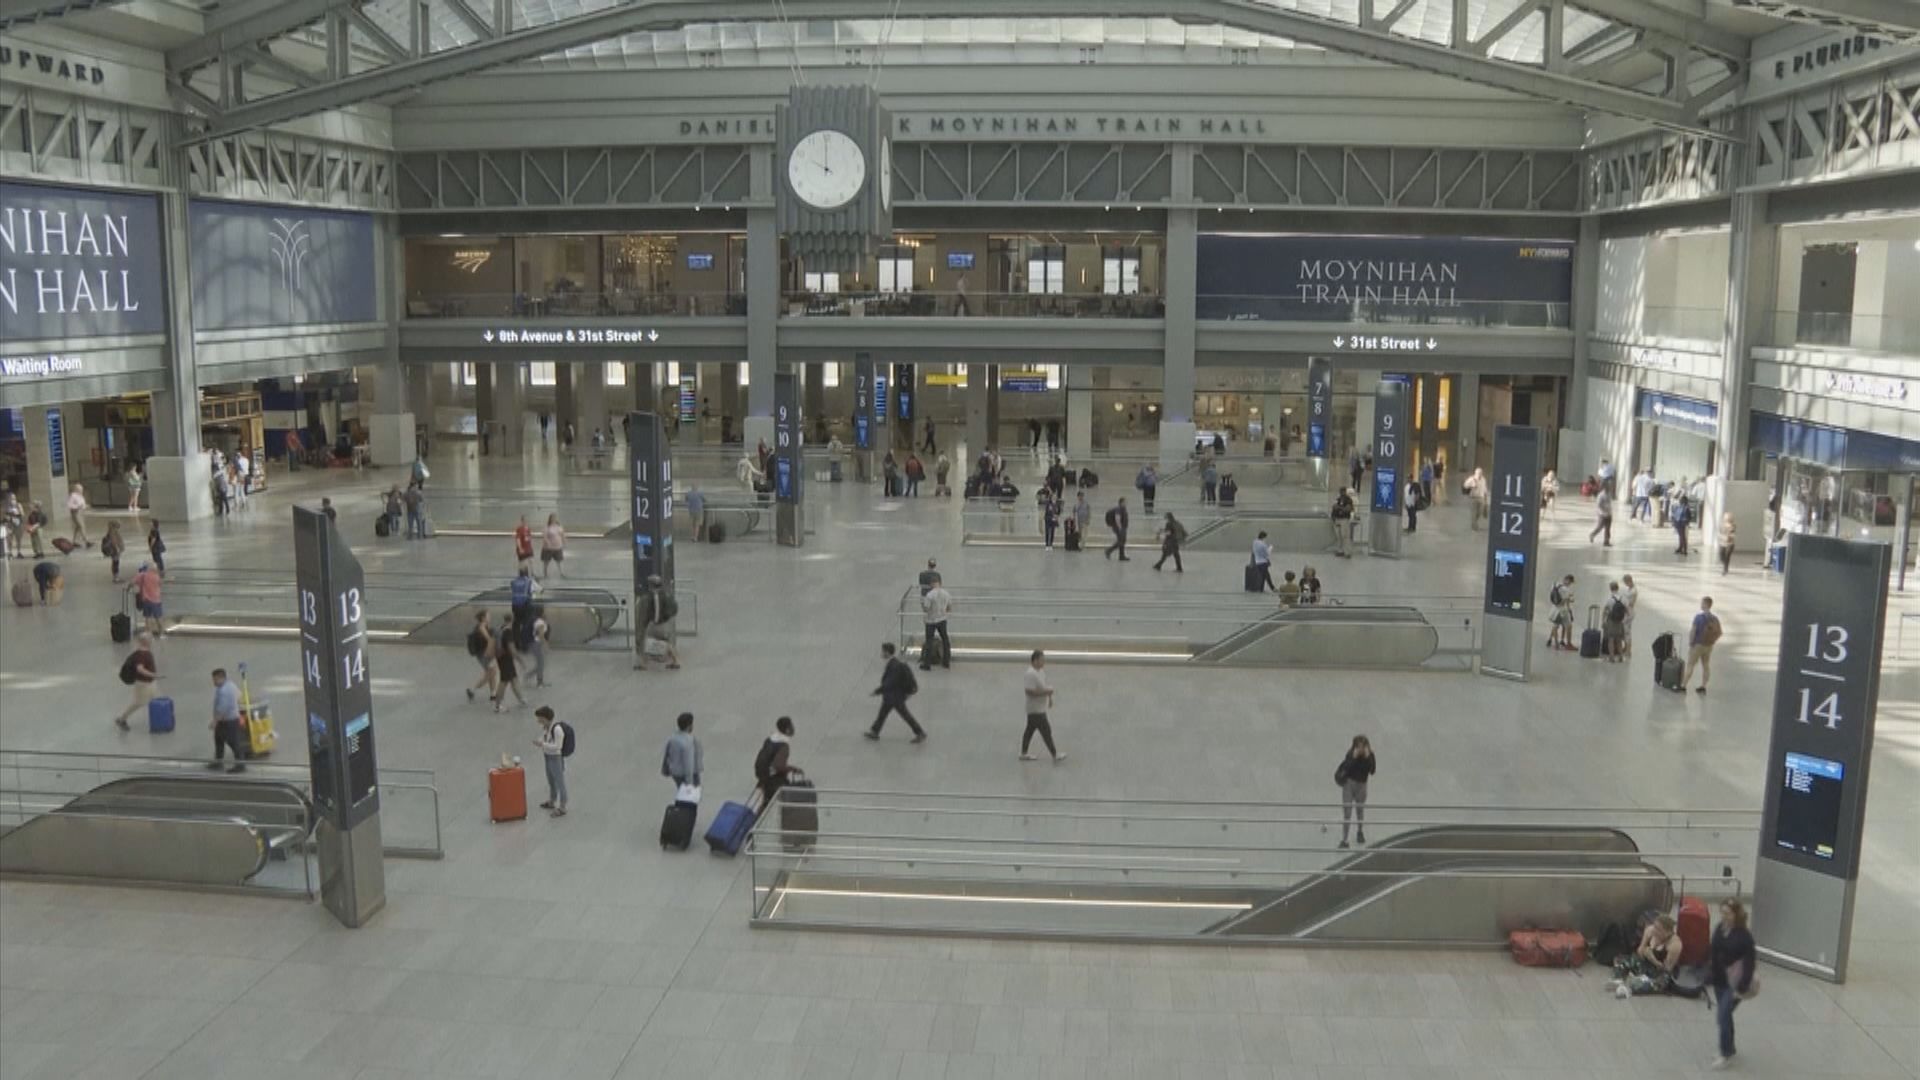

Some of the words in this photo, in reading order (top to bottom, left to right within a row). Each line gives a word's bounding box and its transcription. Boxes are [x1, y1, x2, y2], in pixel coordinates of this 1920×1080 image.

[0, 46, 104, 84] UPWARD
[680, 120, 773, 135] DANIEL
[930, 118, 1077, 133] MOYNIHAN
[1098, 119, 1180, 133] TRAIN
[1200, 120, 1266, 134] HALL
[1299, 260, 1458, 282] MOYNIHAN
[34, 268, 139, 313] HALL
[1296, 284, 1382, 305] TRAIN
[1392, 285, 1461, 307] HALL
[521, 330, 563, 342] Avenue
[565, 330, 575, 342] &
[578, 330, 603, 342] 31st
[606, 330, 642, 342] Street
[1350, 336, 1377, 349] 31st
[1380, 336, 1420, 350] Street
[2, 357, 48, 376] Waiting
[50, 356, 82, 371] Room
[859, 376, 865, 388] 7
[1315, 382, 1323, 394] 7
[779, 405, 787, 421] 9
[1314, 402, 1322, 415] 8
[1383, 414, 1393, 430] 9
[778, 431, 789, 447] 10
[1380, 441, 1395, 456] 10
[637, 460, 647, 482] 11
[1504, 473, 1522, 497] 11
[636, 496, 649, 519] 12
[1501, 512, 1523, 535] 12
[302, 589, 316, 625] 13
[340, 587, 361, 625] 13
[1803, 622, 1848, 663] 13
[305, 650, 321, 689] 14
[343, 647, 365, 689] 14
[1796, 687, 1843, 729] 14
